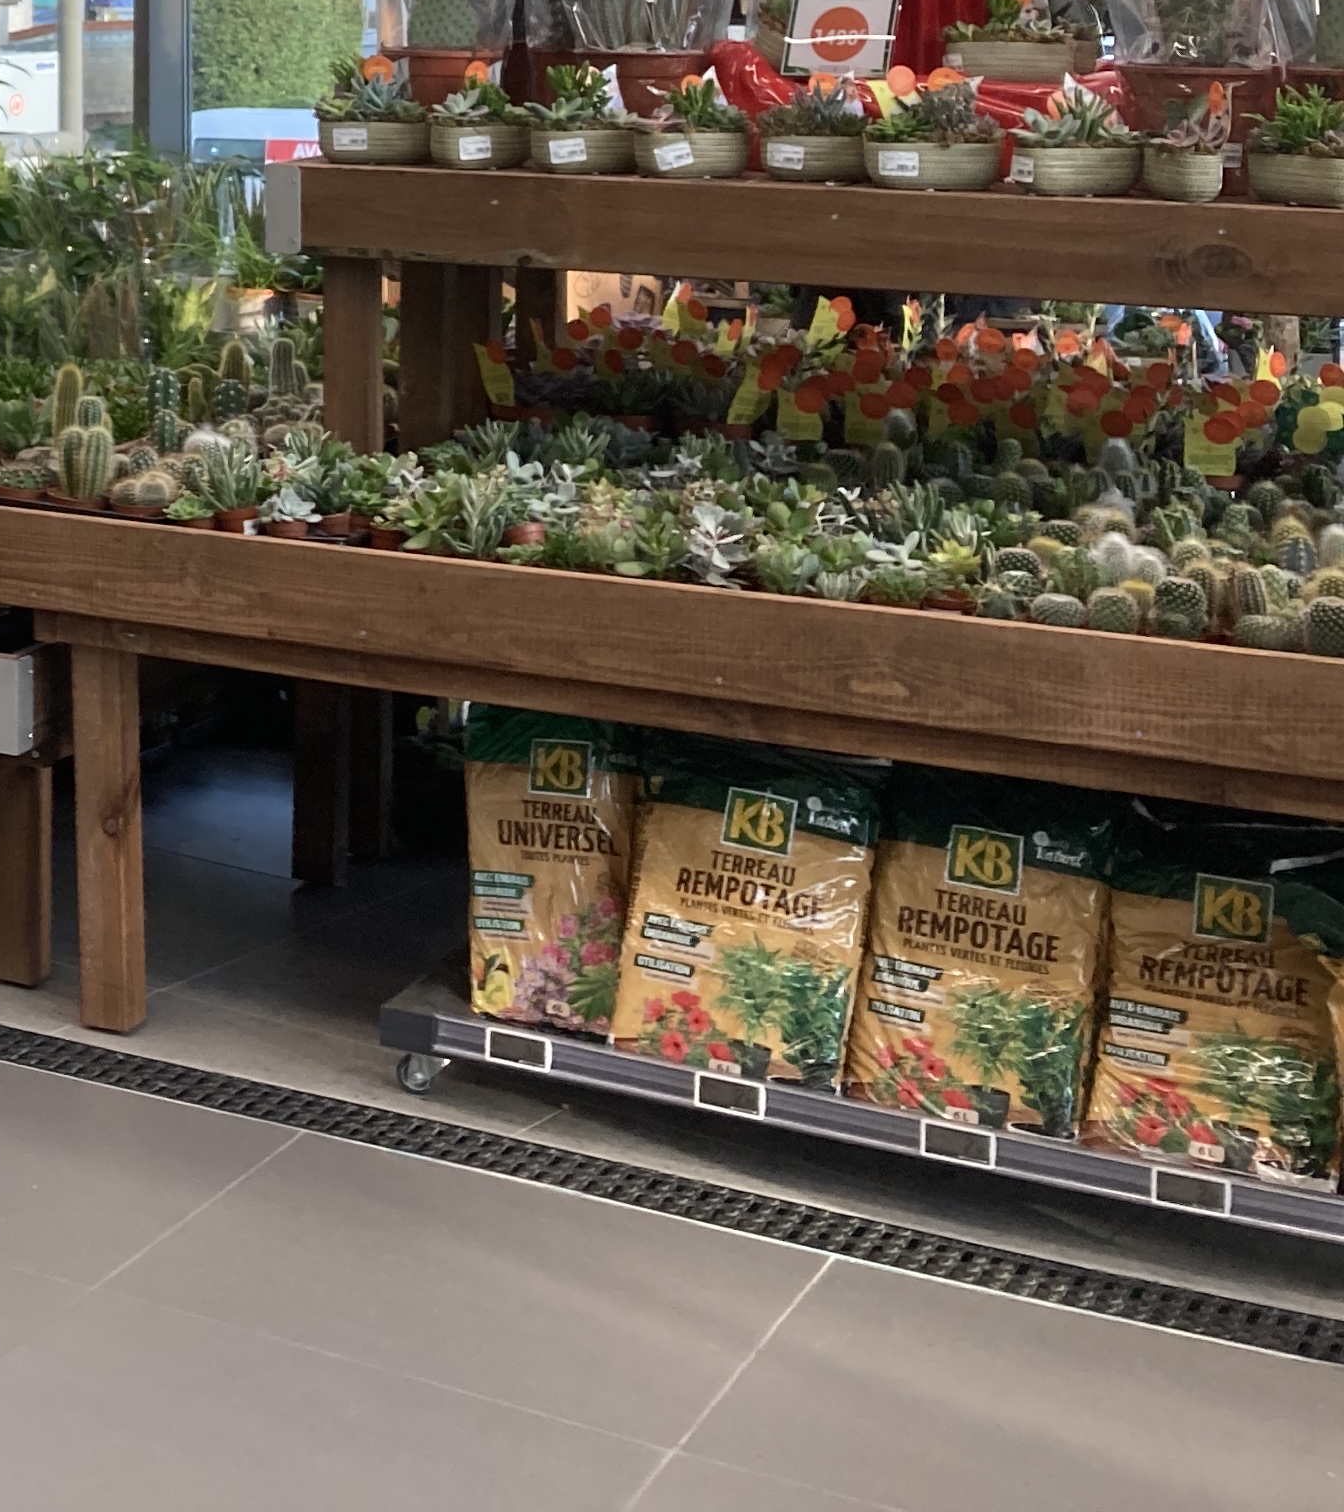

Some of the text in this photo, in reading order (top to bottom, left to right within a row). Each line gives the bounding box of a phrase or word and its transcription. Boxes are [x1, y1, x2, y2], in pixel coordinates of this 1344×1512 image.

[521, 799, 597, 825] TERREAU
[498, 819, 620, 857] UNIVERSEL
[711, 850, 797, 887] TERREAU
[676, 866, 824, 919] REMPOTAGE
[936, 887, 1027, 926] TERREAU
[898, 905, 1061, 964] REMPOTAGE
[1183, 941, 1276, 969] TERREAU
[1138, 954, 1311, 1007] REMPOTAGE
